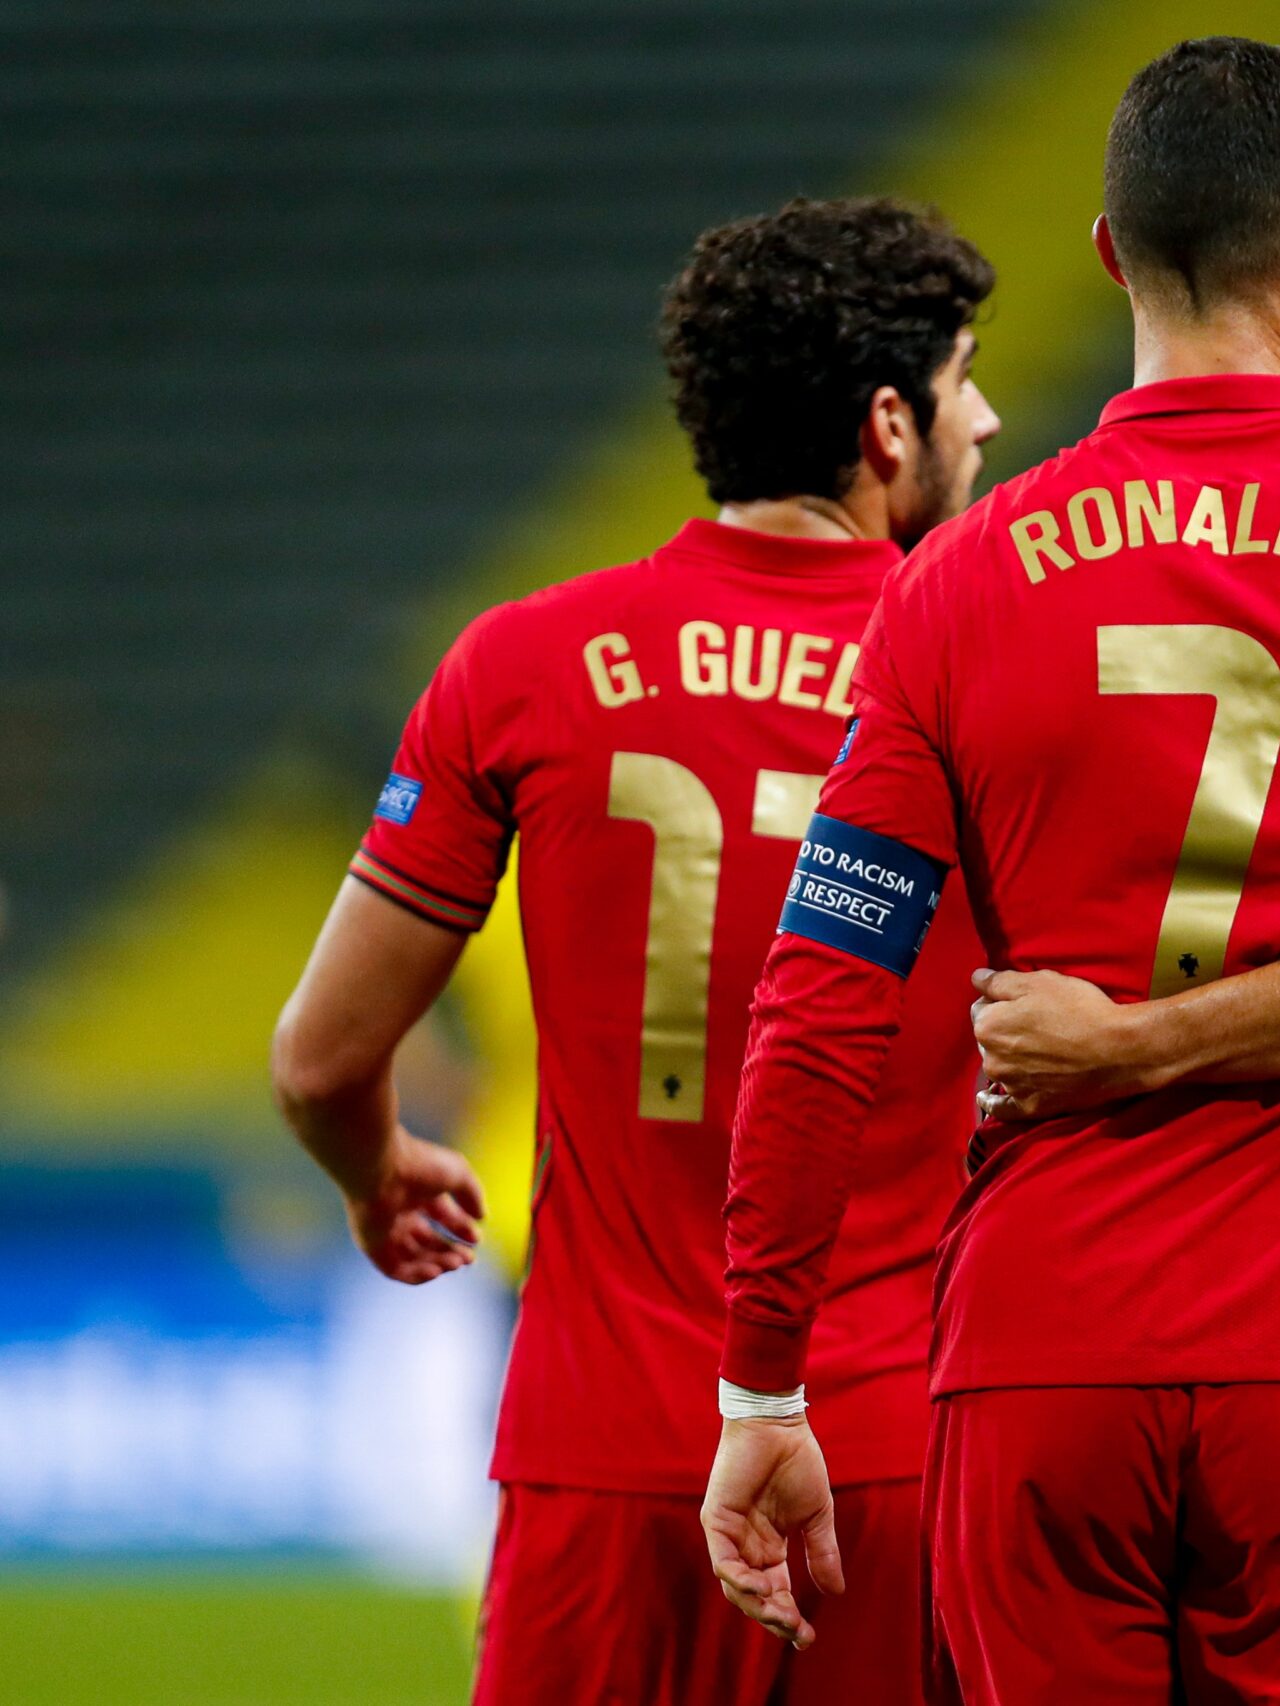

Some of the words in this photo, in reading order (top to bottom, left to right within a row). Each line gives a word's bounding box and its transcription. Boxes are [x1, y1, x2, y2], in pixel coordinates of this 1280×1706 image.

[583, 632, 660, 709] G.
[812, 843, 835, 866] TO
[836, 852, 915, 897] RACISM
[802, 880, 891, 927] RESPECT
